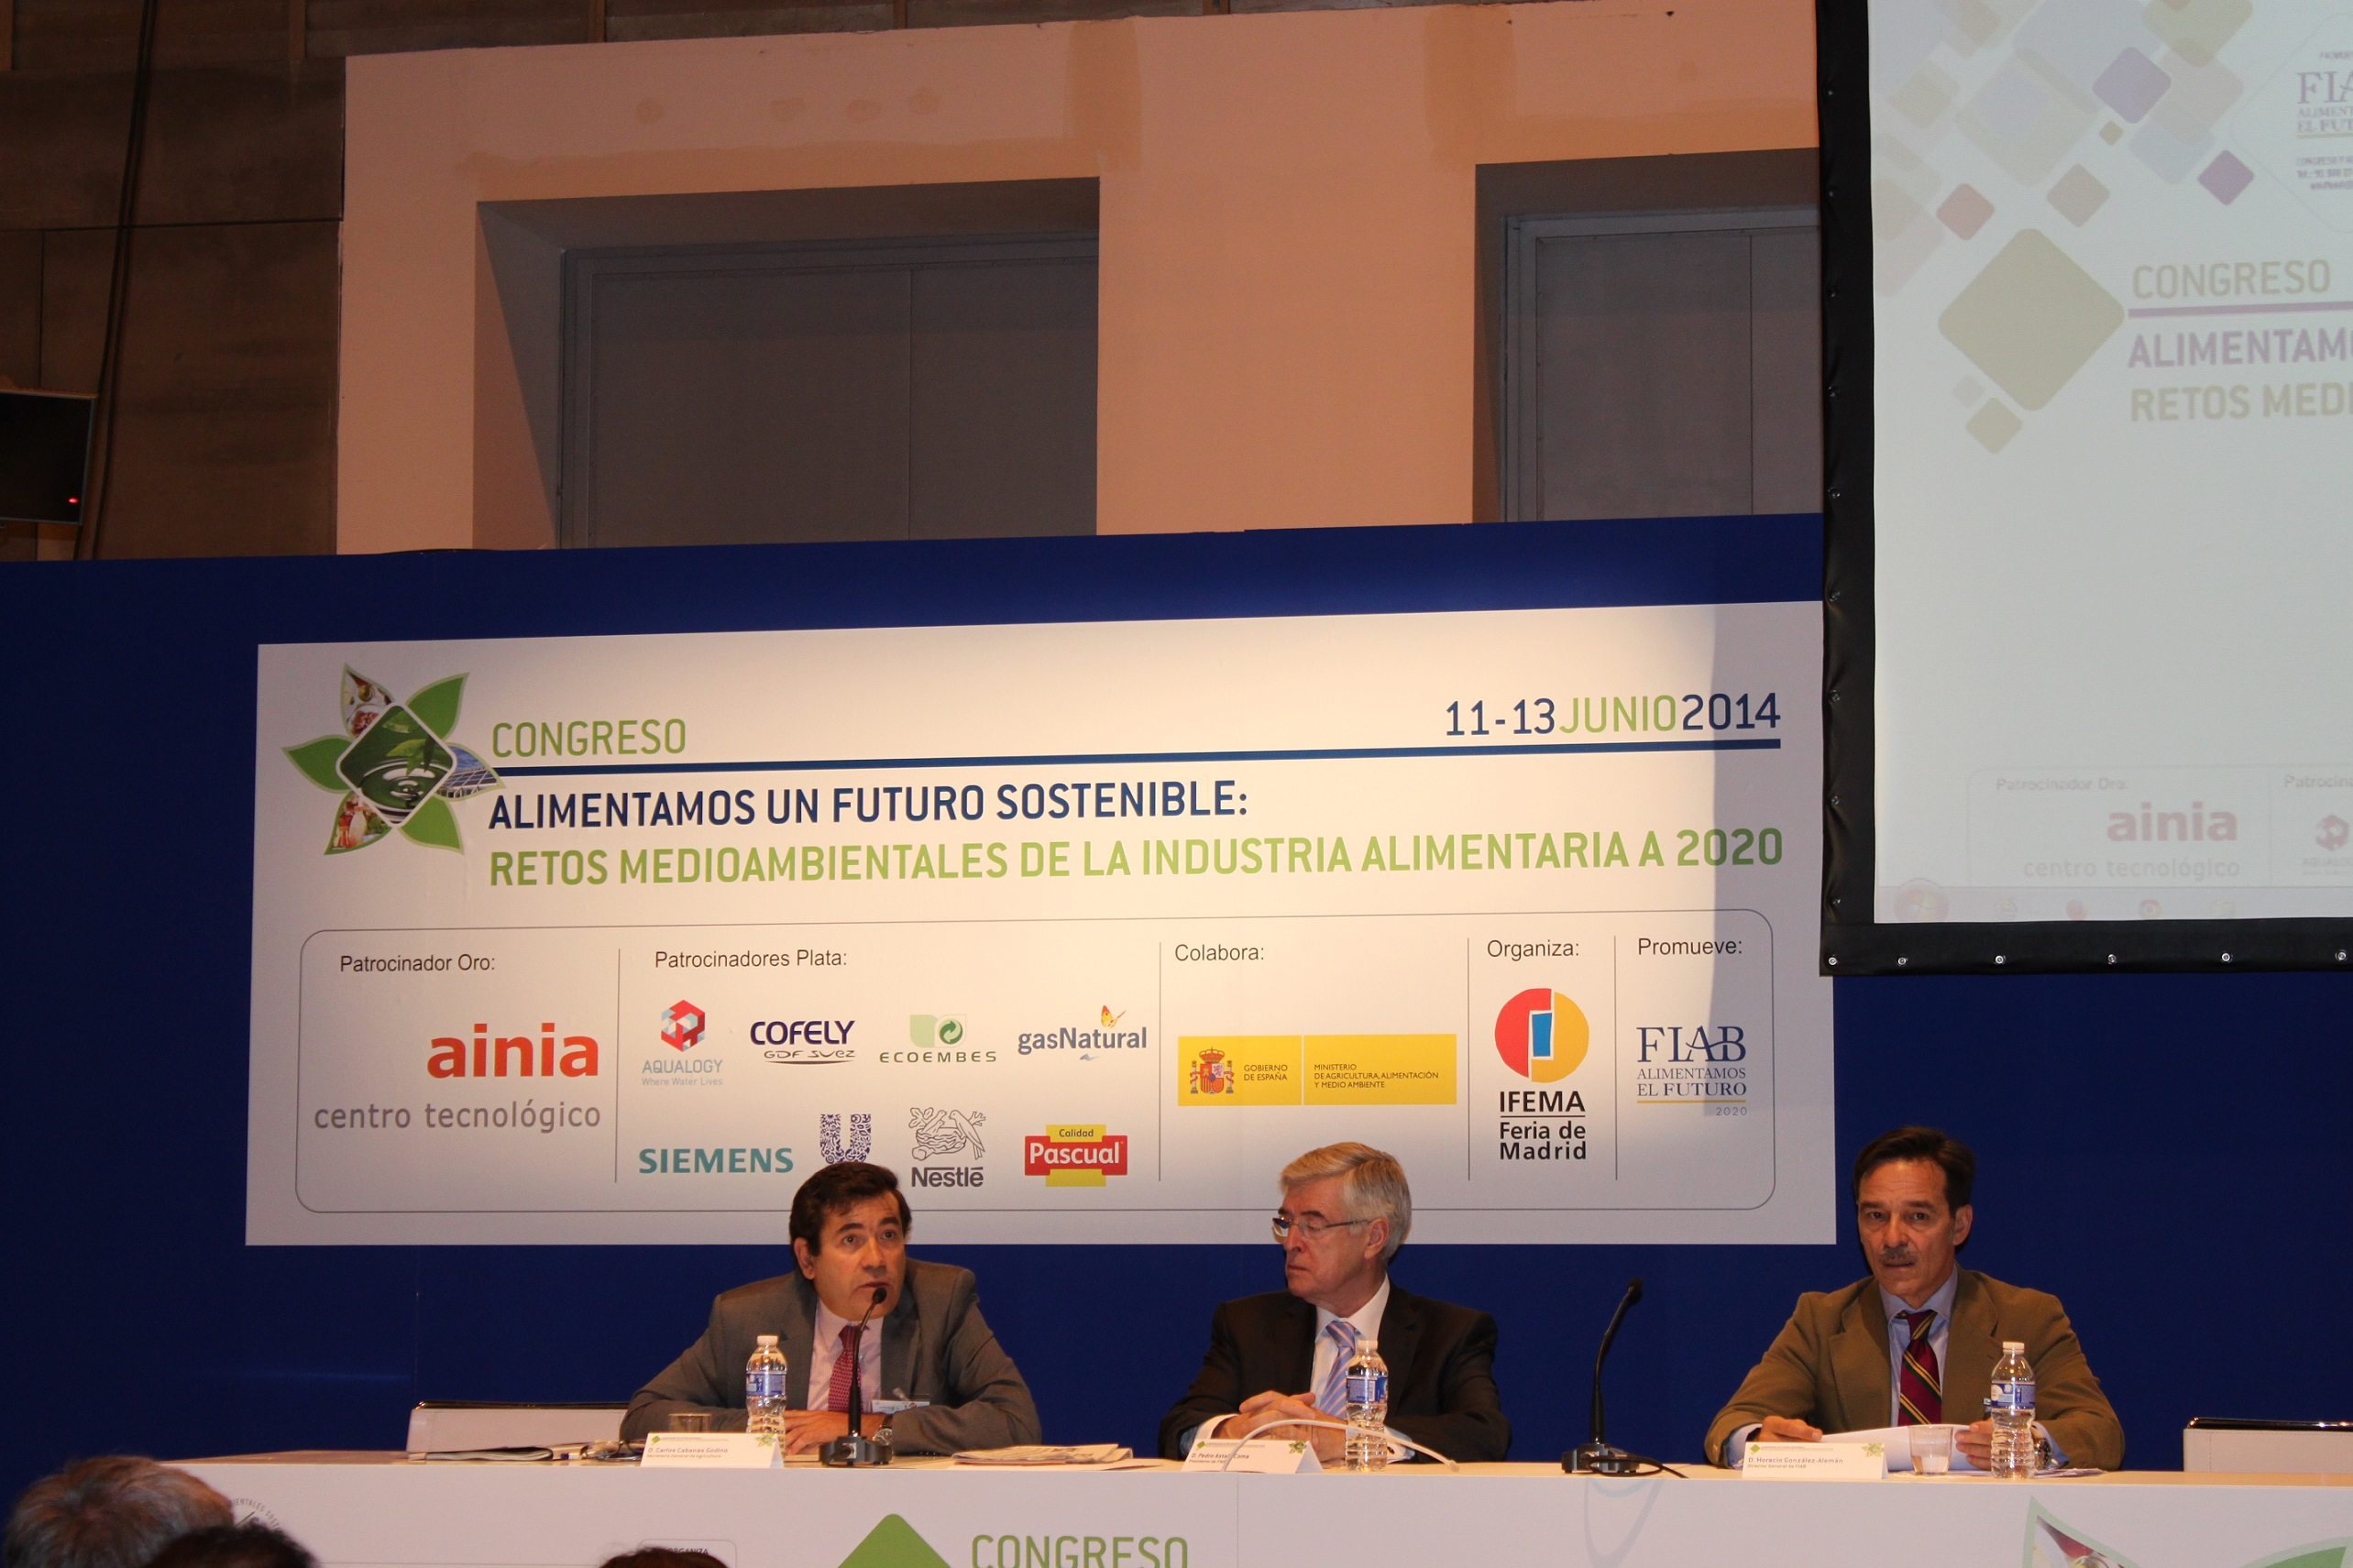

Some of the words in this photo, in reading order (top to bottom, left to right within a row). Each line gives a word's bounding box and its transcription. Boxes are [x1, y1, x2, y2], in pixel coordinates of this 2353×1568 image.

[2132, 258, 2331, 300] CONGRESO
[2128, 327, 2353, 368] ALIMENTAM
[2130, 384, 2250, 422] RETOS
[492, 718, 686, 758] CONGRESO
[488, 789, 755, 829] ALIMENTAMOS
[767, 788, 819, 824] UN
[833, 784, 984, 823] FUTURO
[996, 780, 1248, 820] SOSTENIBLE:
[2107, 800, 2238, 841] ainia
[490, 850, 608, 886] RETOS
[620, 841, 1008, 884] MEDIOAMBIENTALES
[1020, 841, 1071, 878] DE
[1083, 840, 1131, 876] LA
[1143, 836, 1353, 875] INDUSTRIA
[1361, 831, 1630, 872] ALIMENTARIA
[1638, 830, 1665, 867] A
[1677, 827, 1783, 866] 2020
[2023, 860, 2096, 878] centro
[2106, 858, 2240, 882] tecnológico
[1175, 944, 1264, 961] Colabora:
[1487, 939, 1579, 961] Organiza:
[1638, 938, 1743, 955] Promueve:
[340, 955, 452, 972] Patrocinador
[457, 953, 495, 970] Oro:
[654, 950, 790, 968] Patrocinadores
[797, 949, 847, 966] Plata:
[750, 1020, 855, 1045] COFELY
[1017, 1026, 1147, 1056] gasNatural
[427, 1022, 599, 1079] ainia
[764, 1050, 804, 1058] GDF
[1636, 1025, 1746, 1063] FIAB
[642, 1059, 723, 1073] AQUALOGY
[879, 1050, 997, 1063] ECOEMBES
[1244, 1064, 1288, 1072] GOBIERNO
[1257, 1072, 1288, 1080] ESPAÑA
[1380, 1071, 1439, 1080] ALIMENTACIÓN
[1637, 1068, 1746, 1080] ALIMENTAMOS
[642, 1078, 669, 1086] Where
[672, 1078, 697, 1086] Water
[700, 1078, 722, 1086] Lives
[1637, 1083, 1659, 1097] EL
[1663, 1082, 1747, 1097] FUTURO
[1500, 1091, 1586, 1113] IFEMA
[1715, 1106, 1747, 1116] 2020
[314, 1103, 411, 1129] centro
[425, 1099, 600, 1134] tecnológico
[1059, 1128, 1094, 1137] Calidad
[1500, 1121, 1550, 1139] Feria
[1558, 1120, 1586, 1139] de
[639, 1147, 794, 1173] SIEMENS
[1029, 1141, 1119, 1164] Pascual
[1500, 1141, 1587, 1160] Madrid
[911, 1167, 984, 1188] Nestlé
[972, 1534, 1189, 1568] CONGRESO
